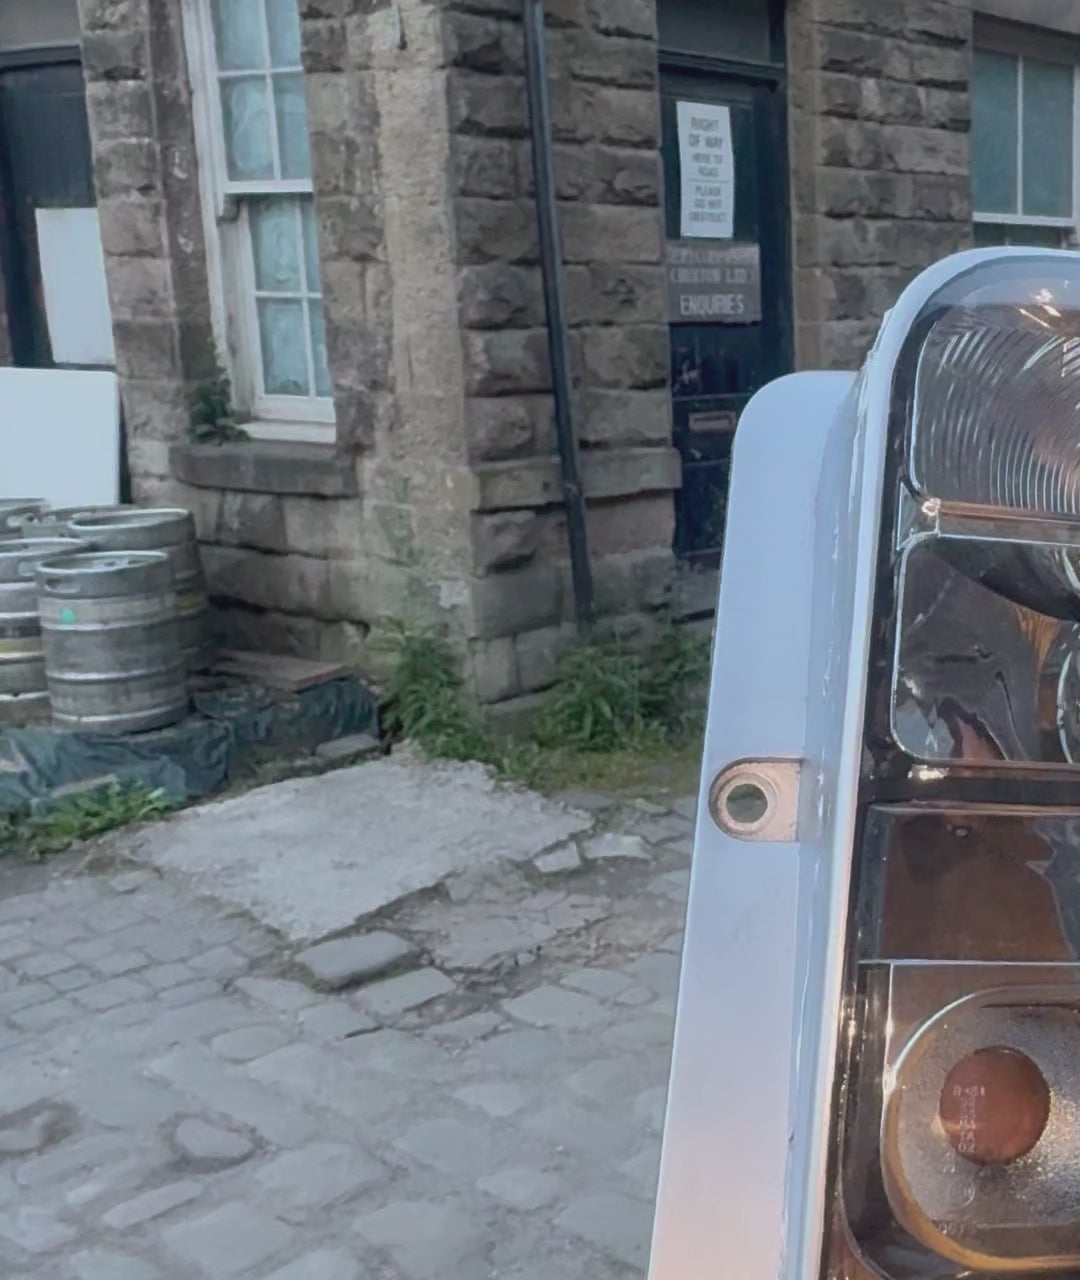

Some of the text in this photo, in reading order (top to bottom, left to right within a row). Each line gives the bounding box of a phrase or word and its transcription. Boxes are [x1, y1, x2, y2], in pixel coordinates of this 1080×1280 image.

[688, 133, 724, 149] OF WAY
[680, 294, 745, 316] ENQUIRIES
